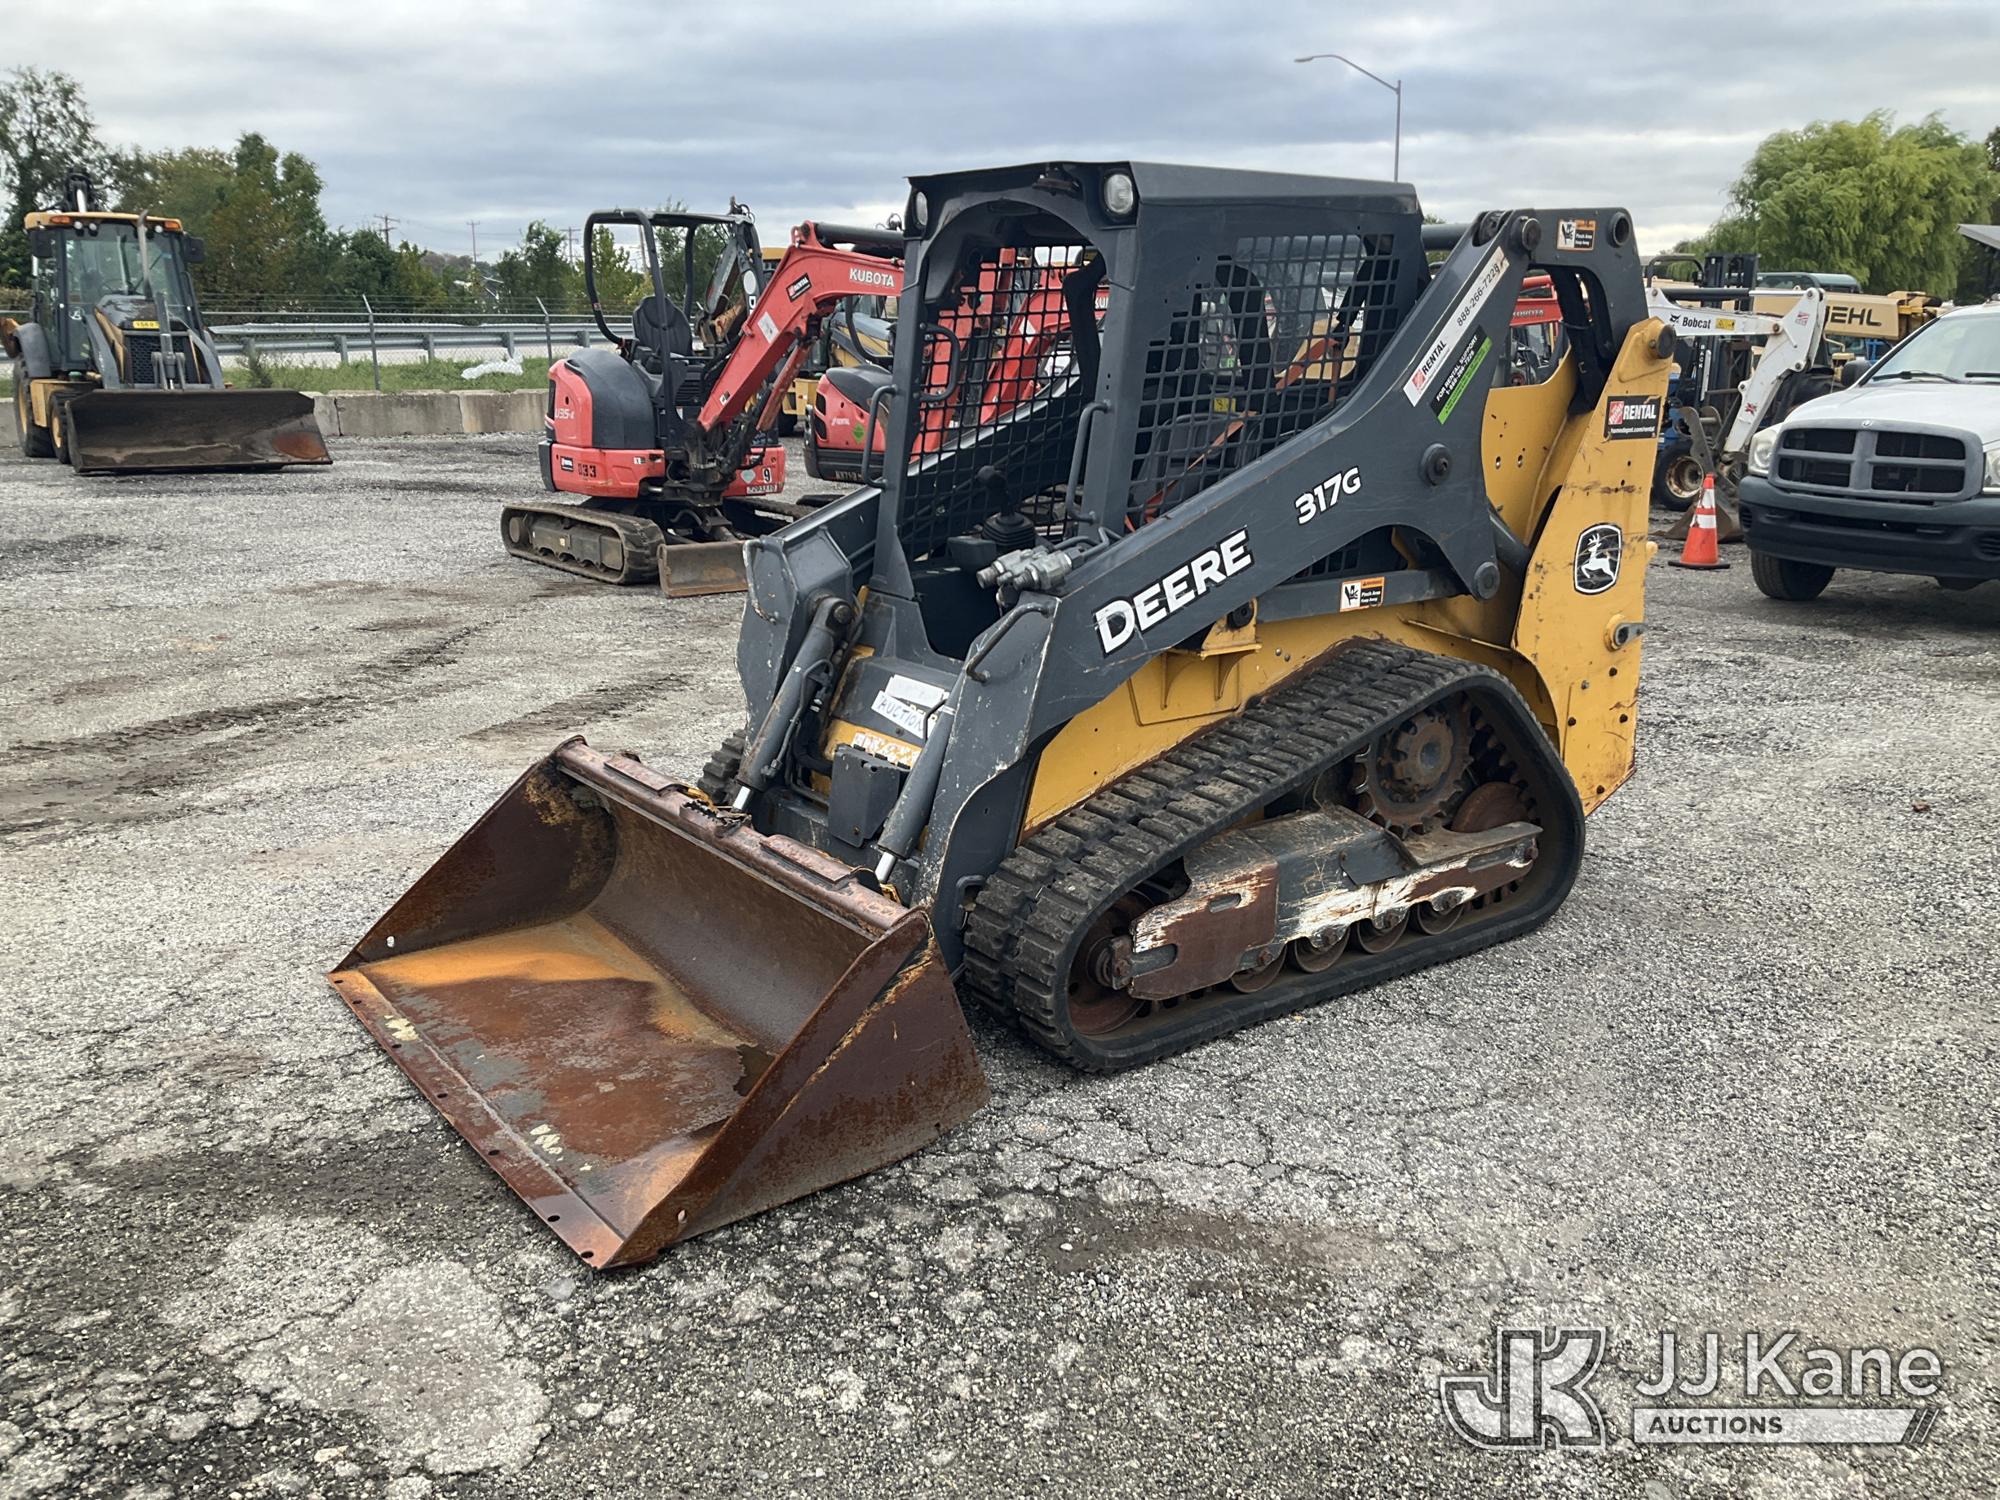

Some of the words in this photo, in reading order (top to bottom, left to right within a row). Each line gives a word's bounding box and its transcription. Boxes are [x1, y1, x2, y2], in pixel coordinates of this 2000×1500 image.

[849, 268, 895, 287] KUBOTA
[1421, 340, 1446, 376] RENTAL
[1457, 263, 1500, 327] 888-266-7228
[1682, 316, 1712, 330] Bobcat
[1825, 305, 1882, 326] EHL
[1436, 386, 1447, 402] FOR
[1444, 364, 1461, 389] RENTAL
[1459, 334, 1478, 365] SUPPORT
[1698, 344, 1706, 369] BACK
[1622, 404, 1657, 420] RENTAL
[763, 468, 771, 482] 9
[1295, 467, 1362, 525] 317G
[1094, 529, 1252, 654] DEERE
[876, 697, 922, 732] AUCTION
